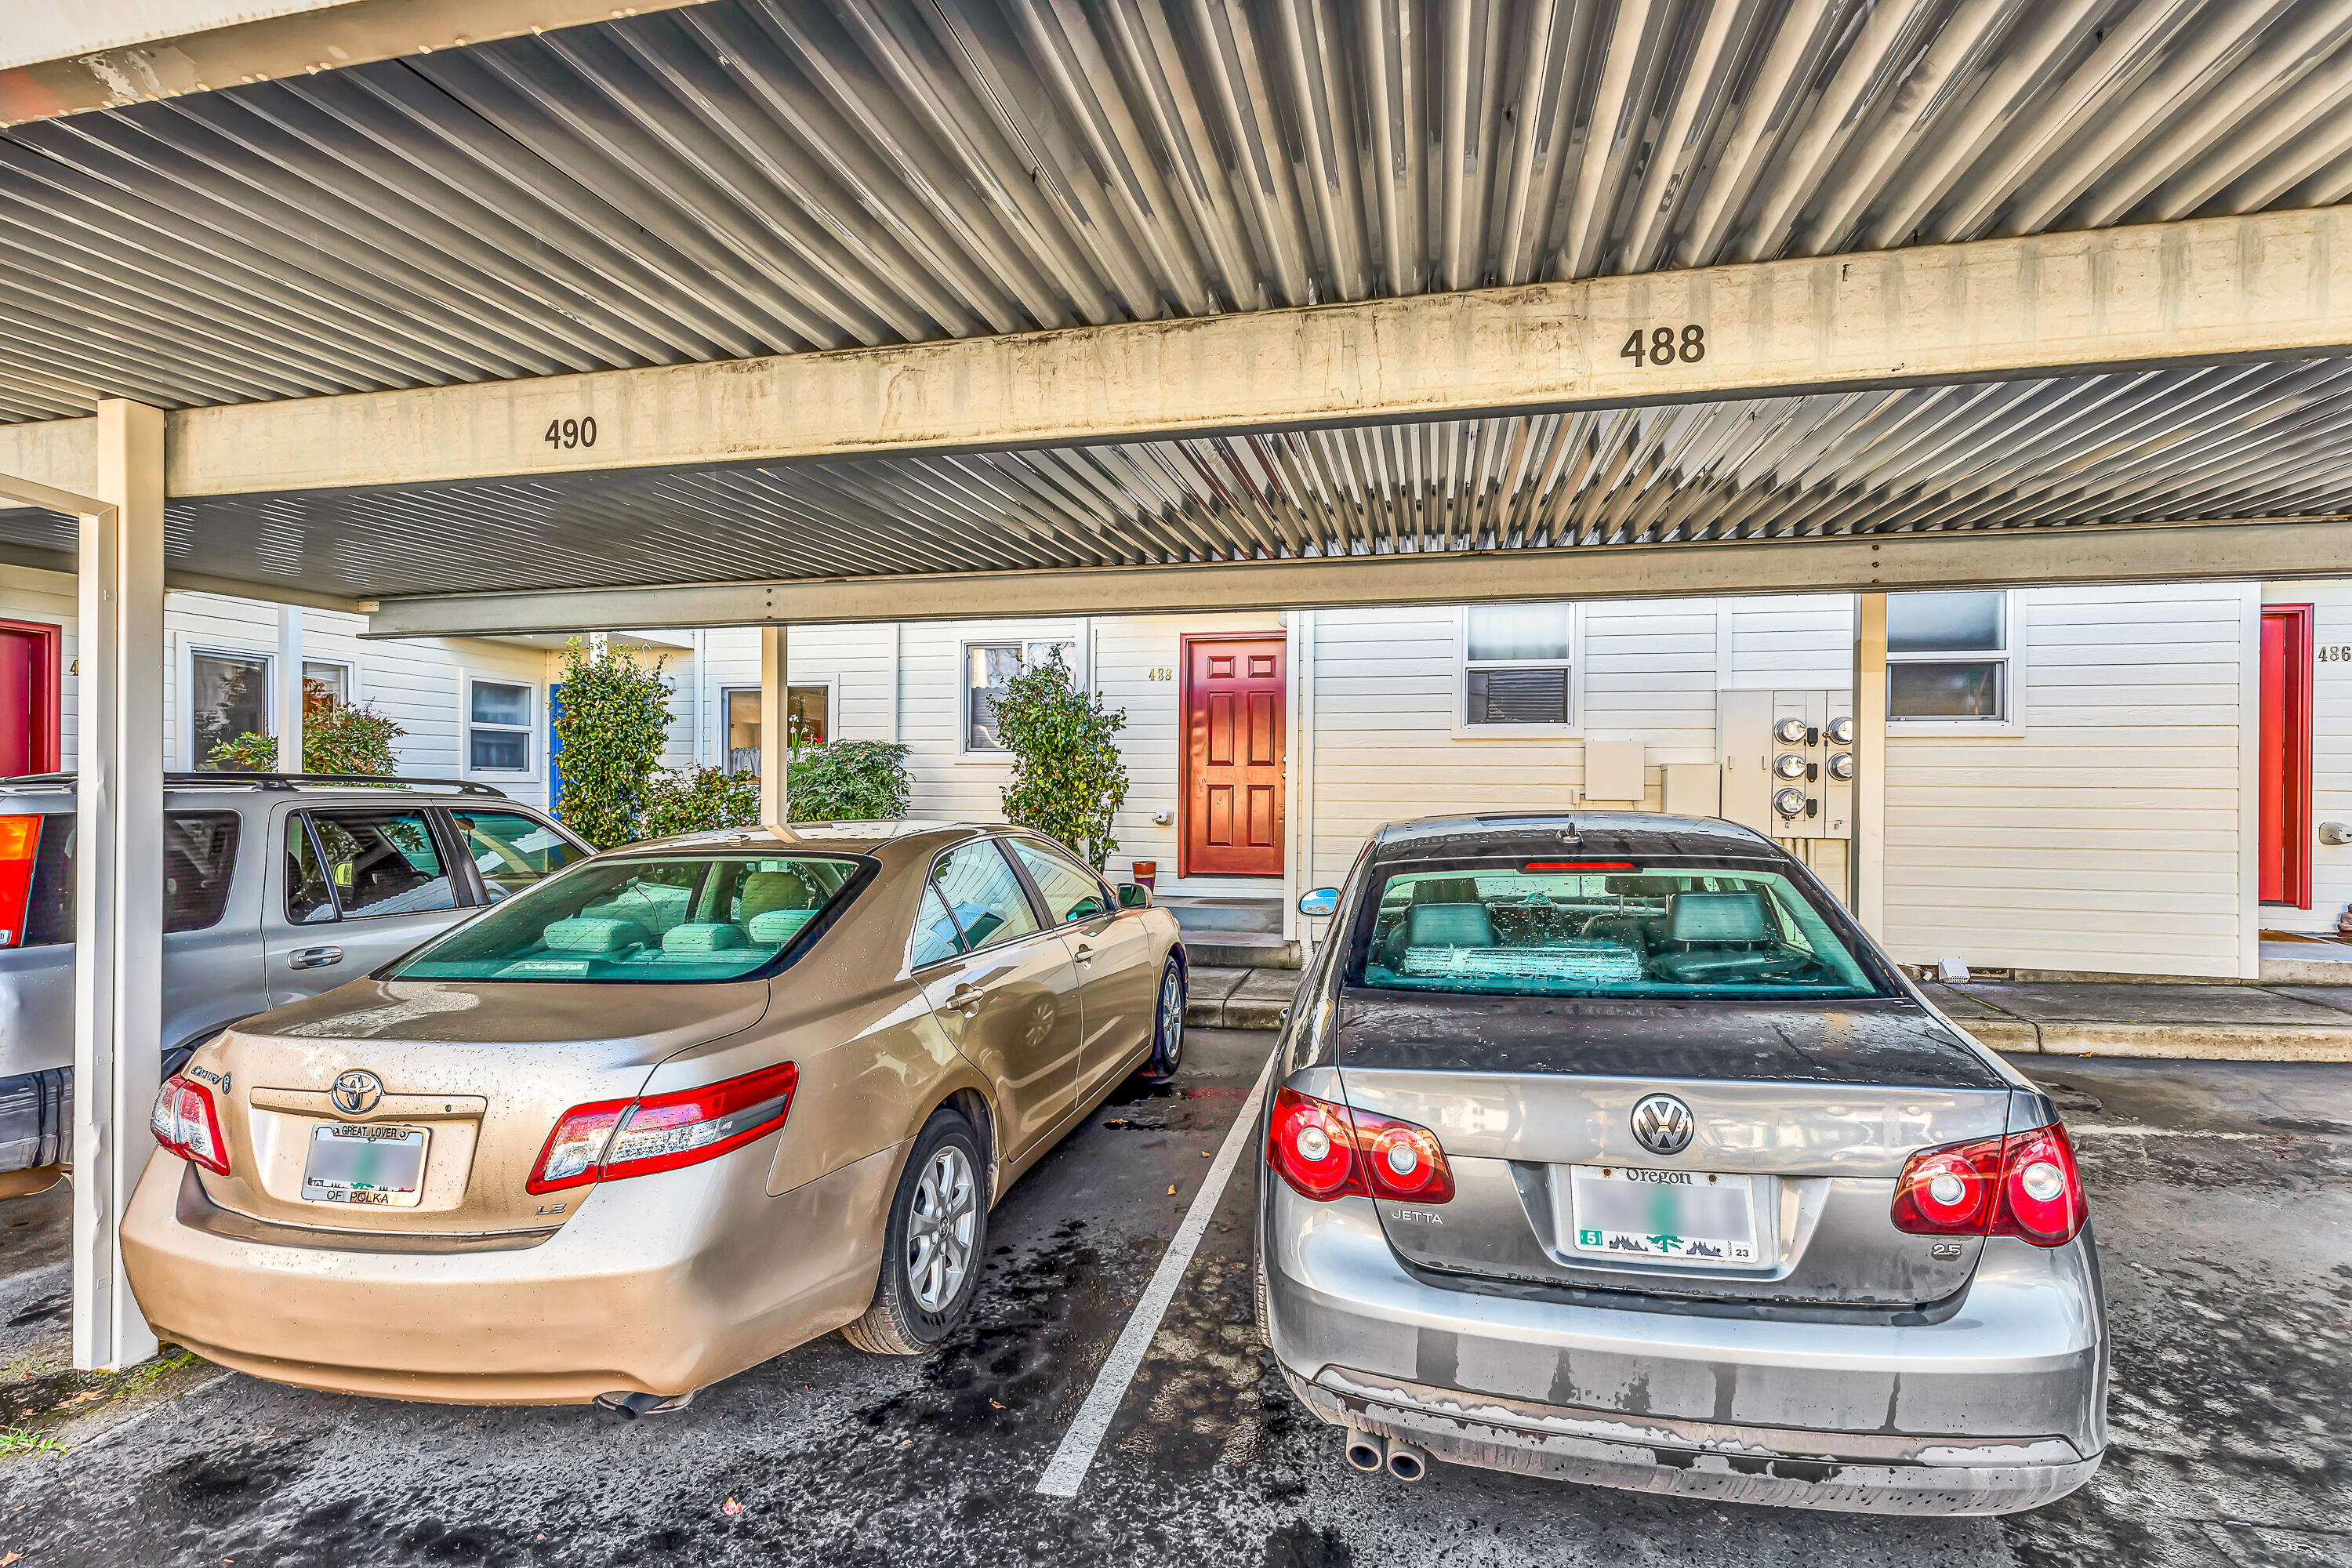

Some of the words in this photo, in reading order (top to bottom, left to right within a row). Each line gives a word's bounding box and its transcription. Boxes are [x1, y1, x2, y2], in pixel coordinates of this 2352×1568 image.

[1620, 324, 1705, 368] 488
[544, 416, 597, 449] 490
[2318, 645, 2351, 662] 486
[1149, 668, 1172, 681] 488
[342, 1125, 367, 1137] GREAT
[371, 1127, 397, 1138] LOVER
[1626, 1168, 1693, 1185] Oregon
[326, 1190, 343, 1200] OF
[350, 1191, 389, 1203] POLKA
[535, 1203, 567, 1215] LE
[1392, 1209, 1443, 1225] JETTA
[1586, 1231, 1597, 1245] 5
[1736, 1248, 1749, 1257] 23
